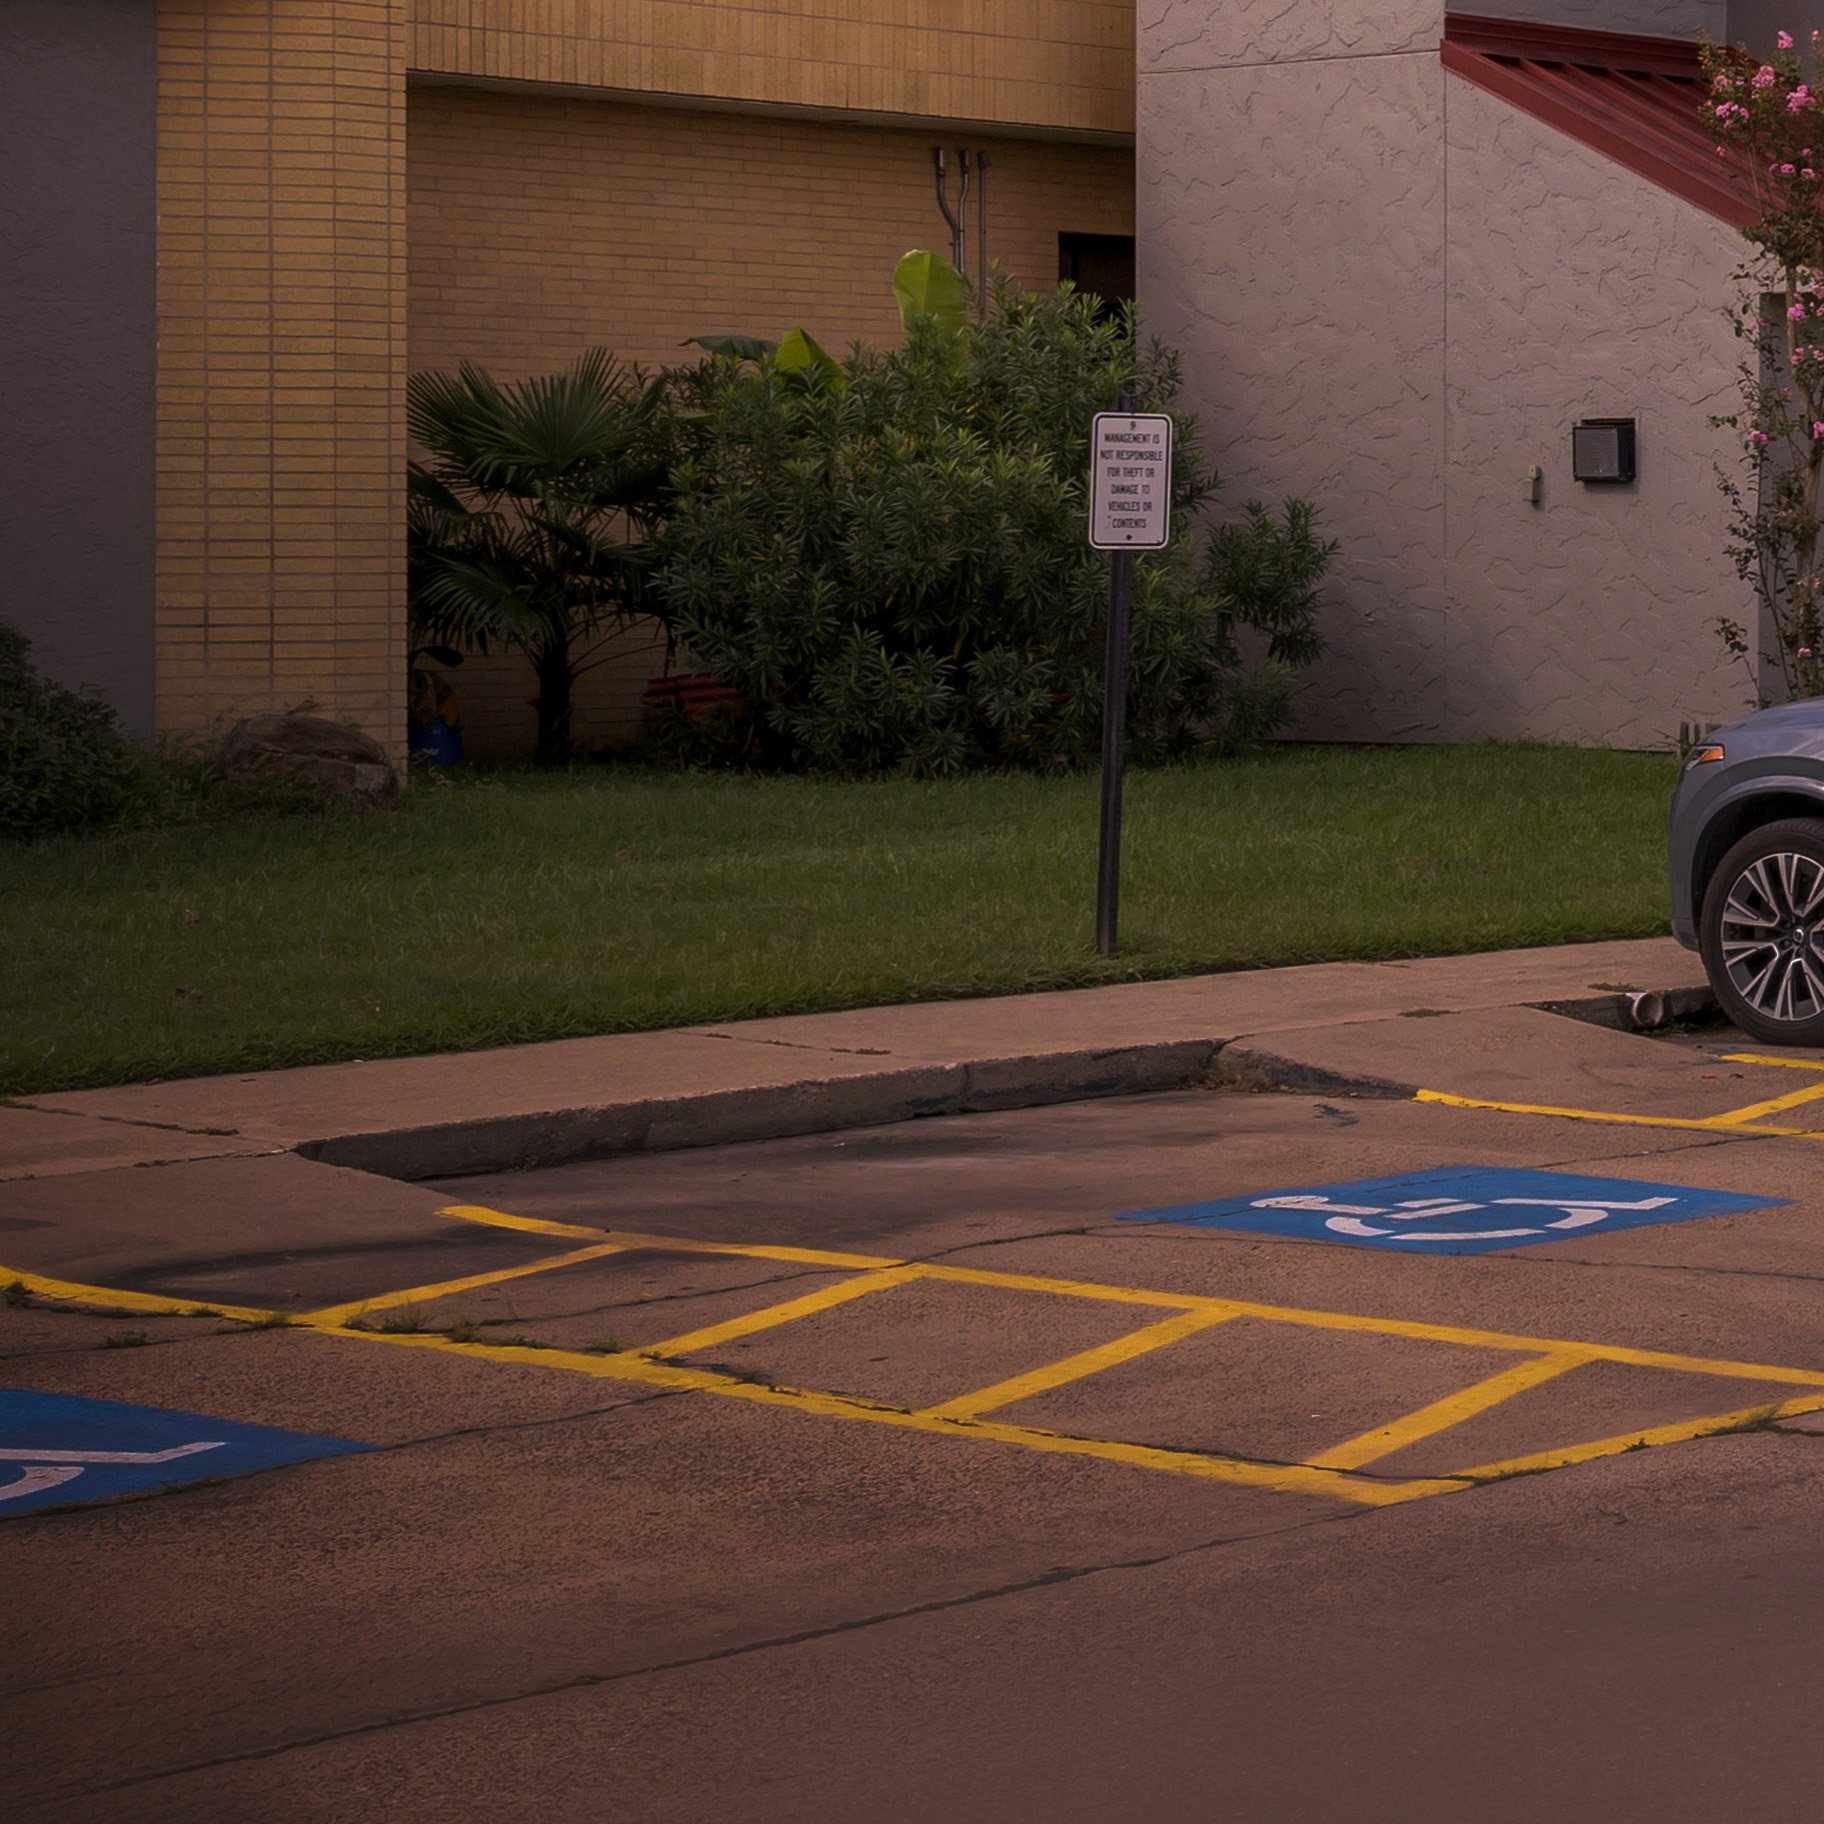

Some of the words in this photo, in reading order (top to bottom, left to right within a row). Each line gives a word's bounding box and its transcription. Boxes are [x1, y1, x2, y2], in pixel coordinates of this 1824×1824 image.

[1104, 433, 1151, 443] MANAGEMENT
[1152, 434, 1160, 444] IS
[1100, 450, 1114, 460] NOT
[1115, 450, 1162, 461] RESPONSIBLE
[1107, 467, 1121, 478] FOR
[1122, 467, 1143, 478] THEFT
[1145, 468, 1155, 478] OR
[1111, 484, 1139, 495] DAMAGE
[1141, 485, 1151, 495] TO
[1108, 501, 1140, 512] VEHICLES
[1142, 502, 1152, 512] OR
[1111, 518, 1147, 529] CONTENTS
